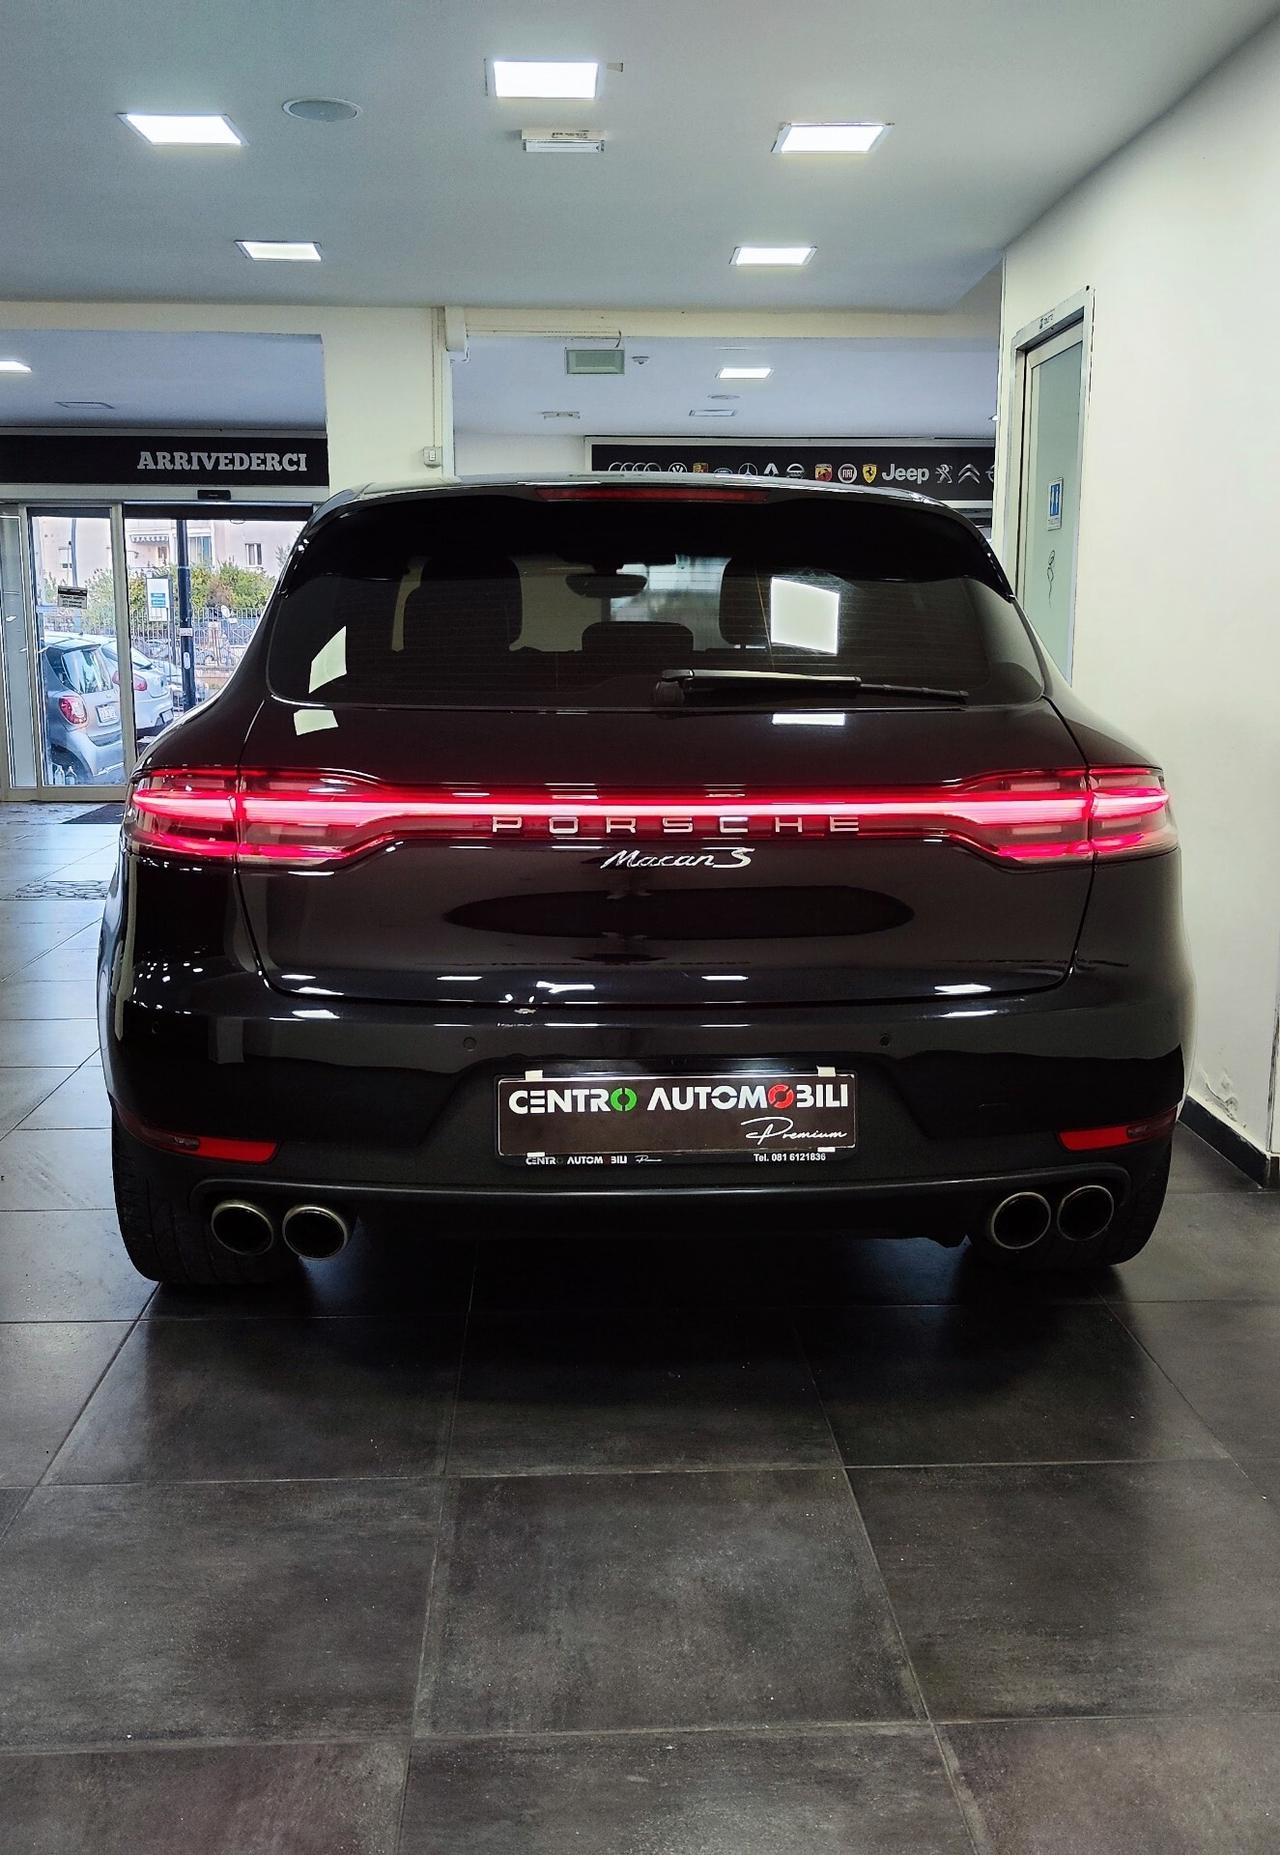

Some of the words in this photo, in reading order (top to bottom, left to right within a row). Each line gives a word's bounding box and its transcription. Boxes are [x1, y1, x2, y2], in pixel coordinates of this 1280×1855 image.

[137, 452, 307, 471] ARRIVEDERCI
[882, 464, 930, 484] Jeep
[492, 816, 859, 834] PORSCHE
[600, 850, 715, 869] Macan
[712, 847, 755, 869] S
[508, 1087, 638, 1115] CENTRO
[647, 1083, 848, 1111] AUTOMOBILI
[740, 1116, 848, 1145] Premium
[753, 1153, 769, 1162] Tel.
[771, 1153, 787, 1162] 081
